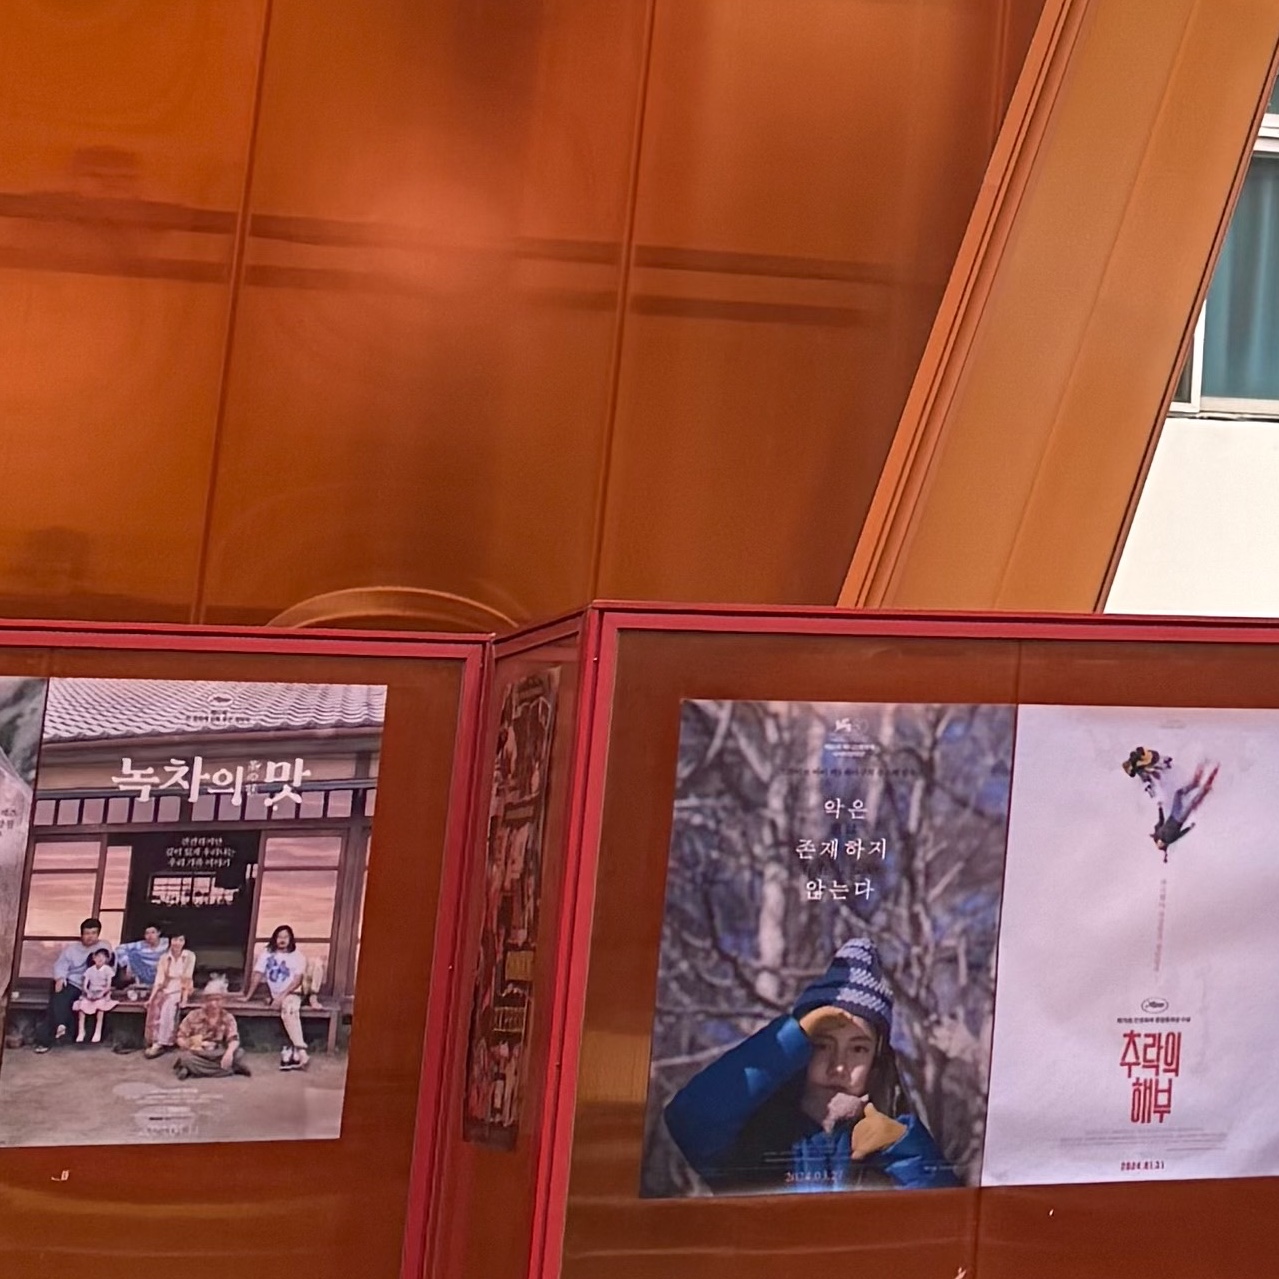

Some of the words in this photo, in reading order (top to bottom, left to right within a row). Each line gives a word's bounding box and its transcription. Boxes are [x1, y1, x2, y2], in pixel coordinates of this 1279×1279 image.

[111, 756, 244, 807] 녹차의
[263, 757, 312, 811] 맛
[824, 797, 869, 820] 악은
[796, 837, 887, 861] 존재하지
[806, 877, 875, 901] 않는다
[1119, 1029, 1182, 1079] 추락의
[1130, 1077, 1173, 1124] 해부
